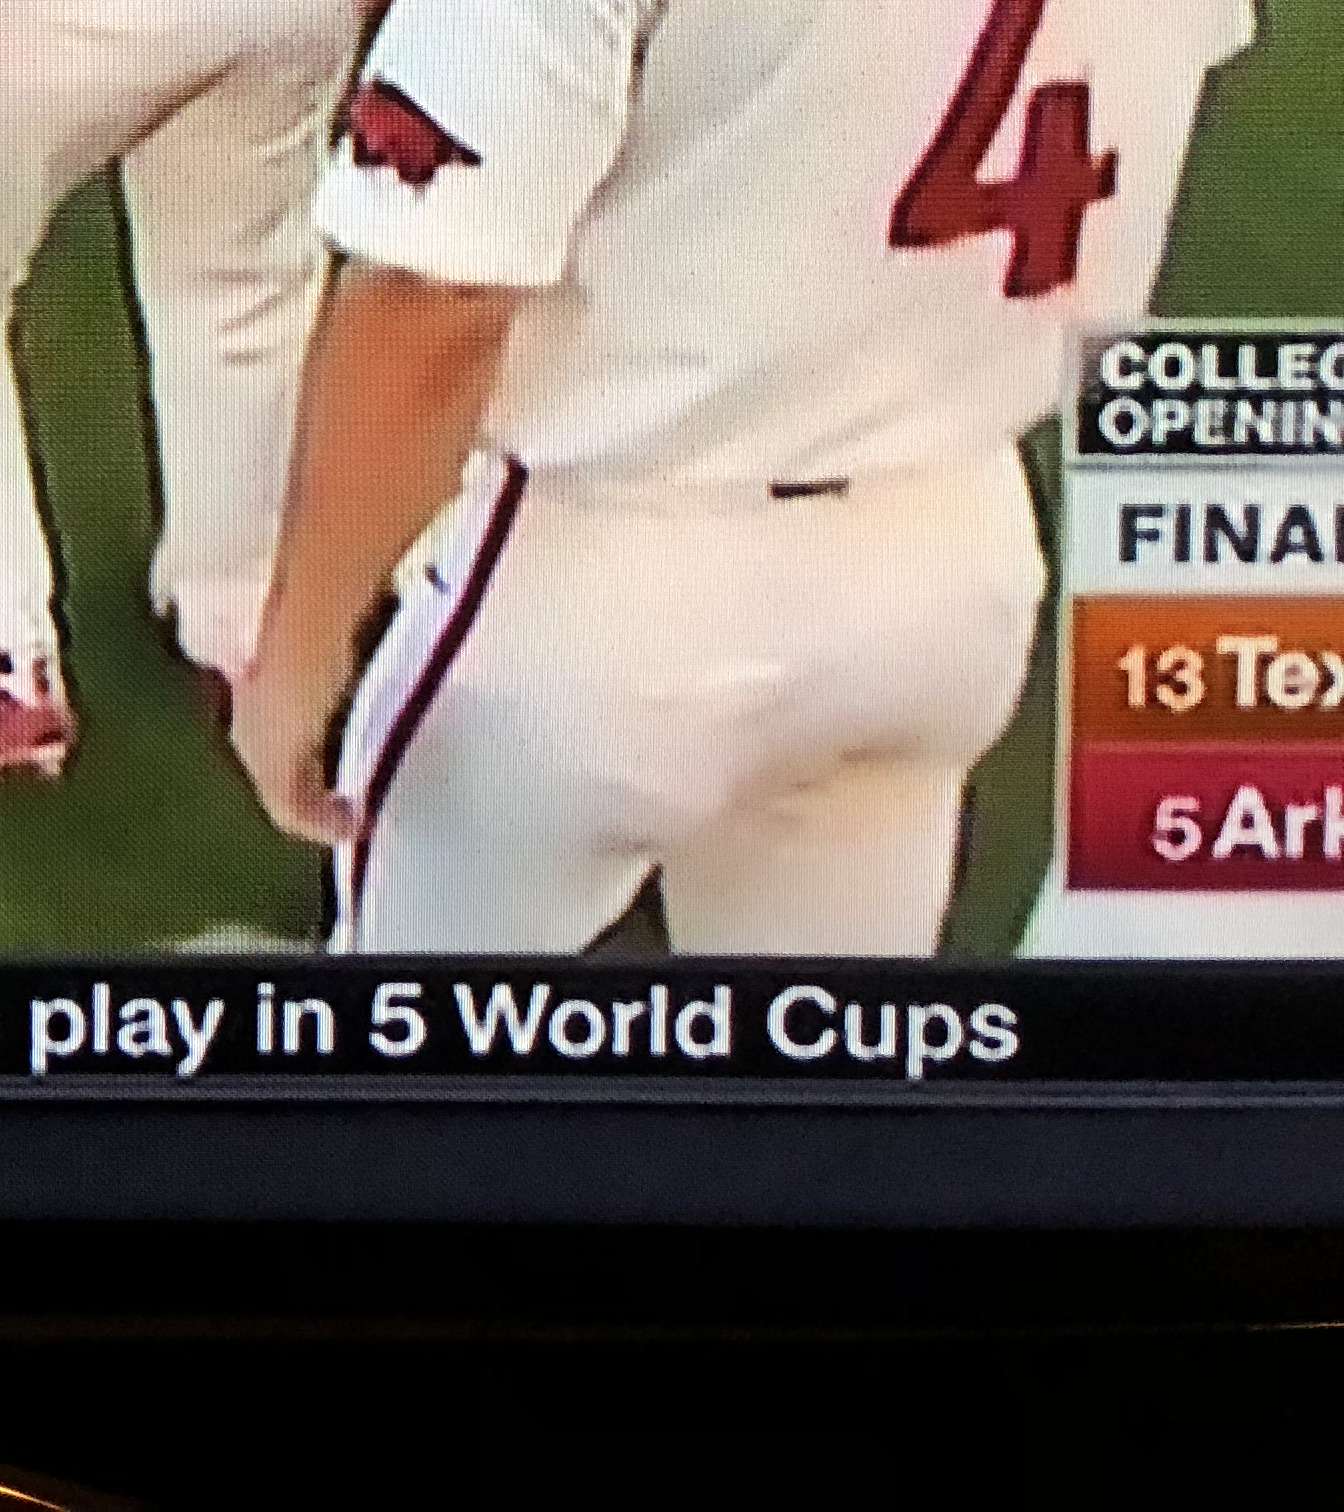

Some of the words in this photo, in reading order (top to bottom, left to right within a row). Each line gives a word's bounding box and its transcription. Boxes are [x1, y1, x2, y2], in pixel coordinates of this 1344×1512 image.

[1118, 503, 1344, 563] FINA
[1118, 643, 1207, 713] 13
[1152, 795, 1203, 861] 5
[29, 982, 224, 1079] play
[256, 982, 336, 1057] in
[368, 982, 428, 1057] 5
[453, 982, 731, 1059] World
[766, 983, 1020, 1083] Cups
